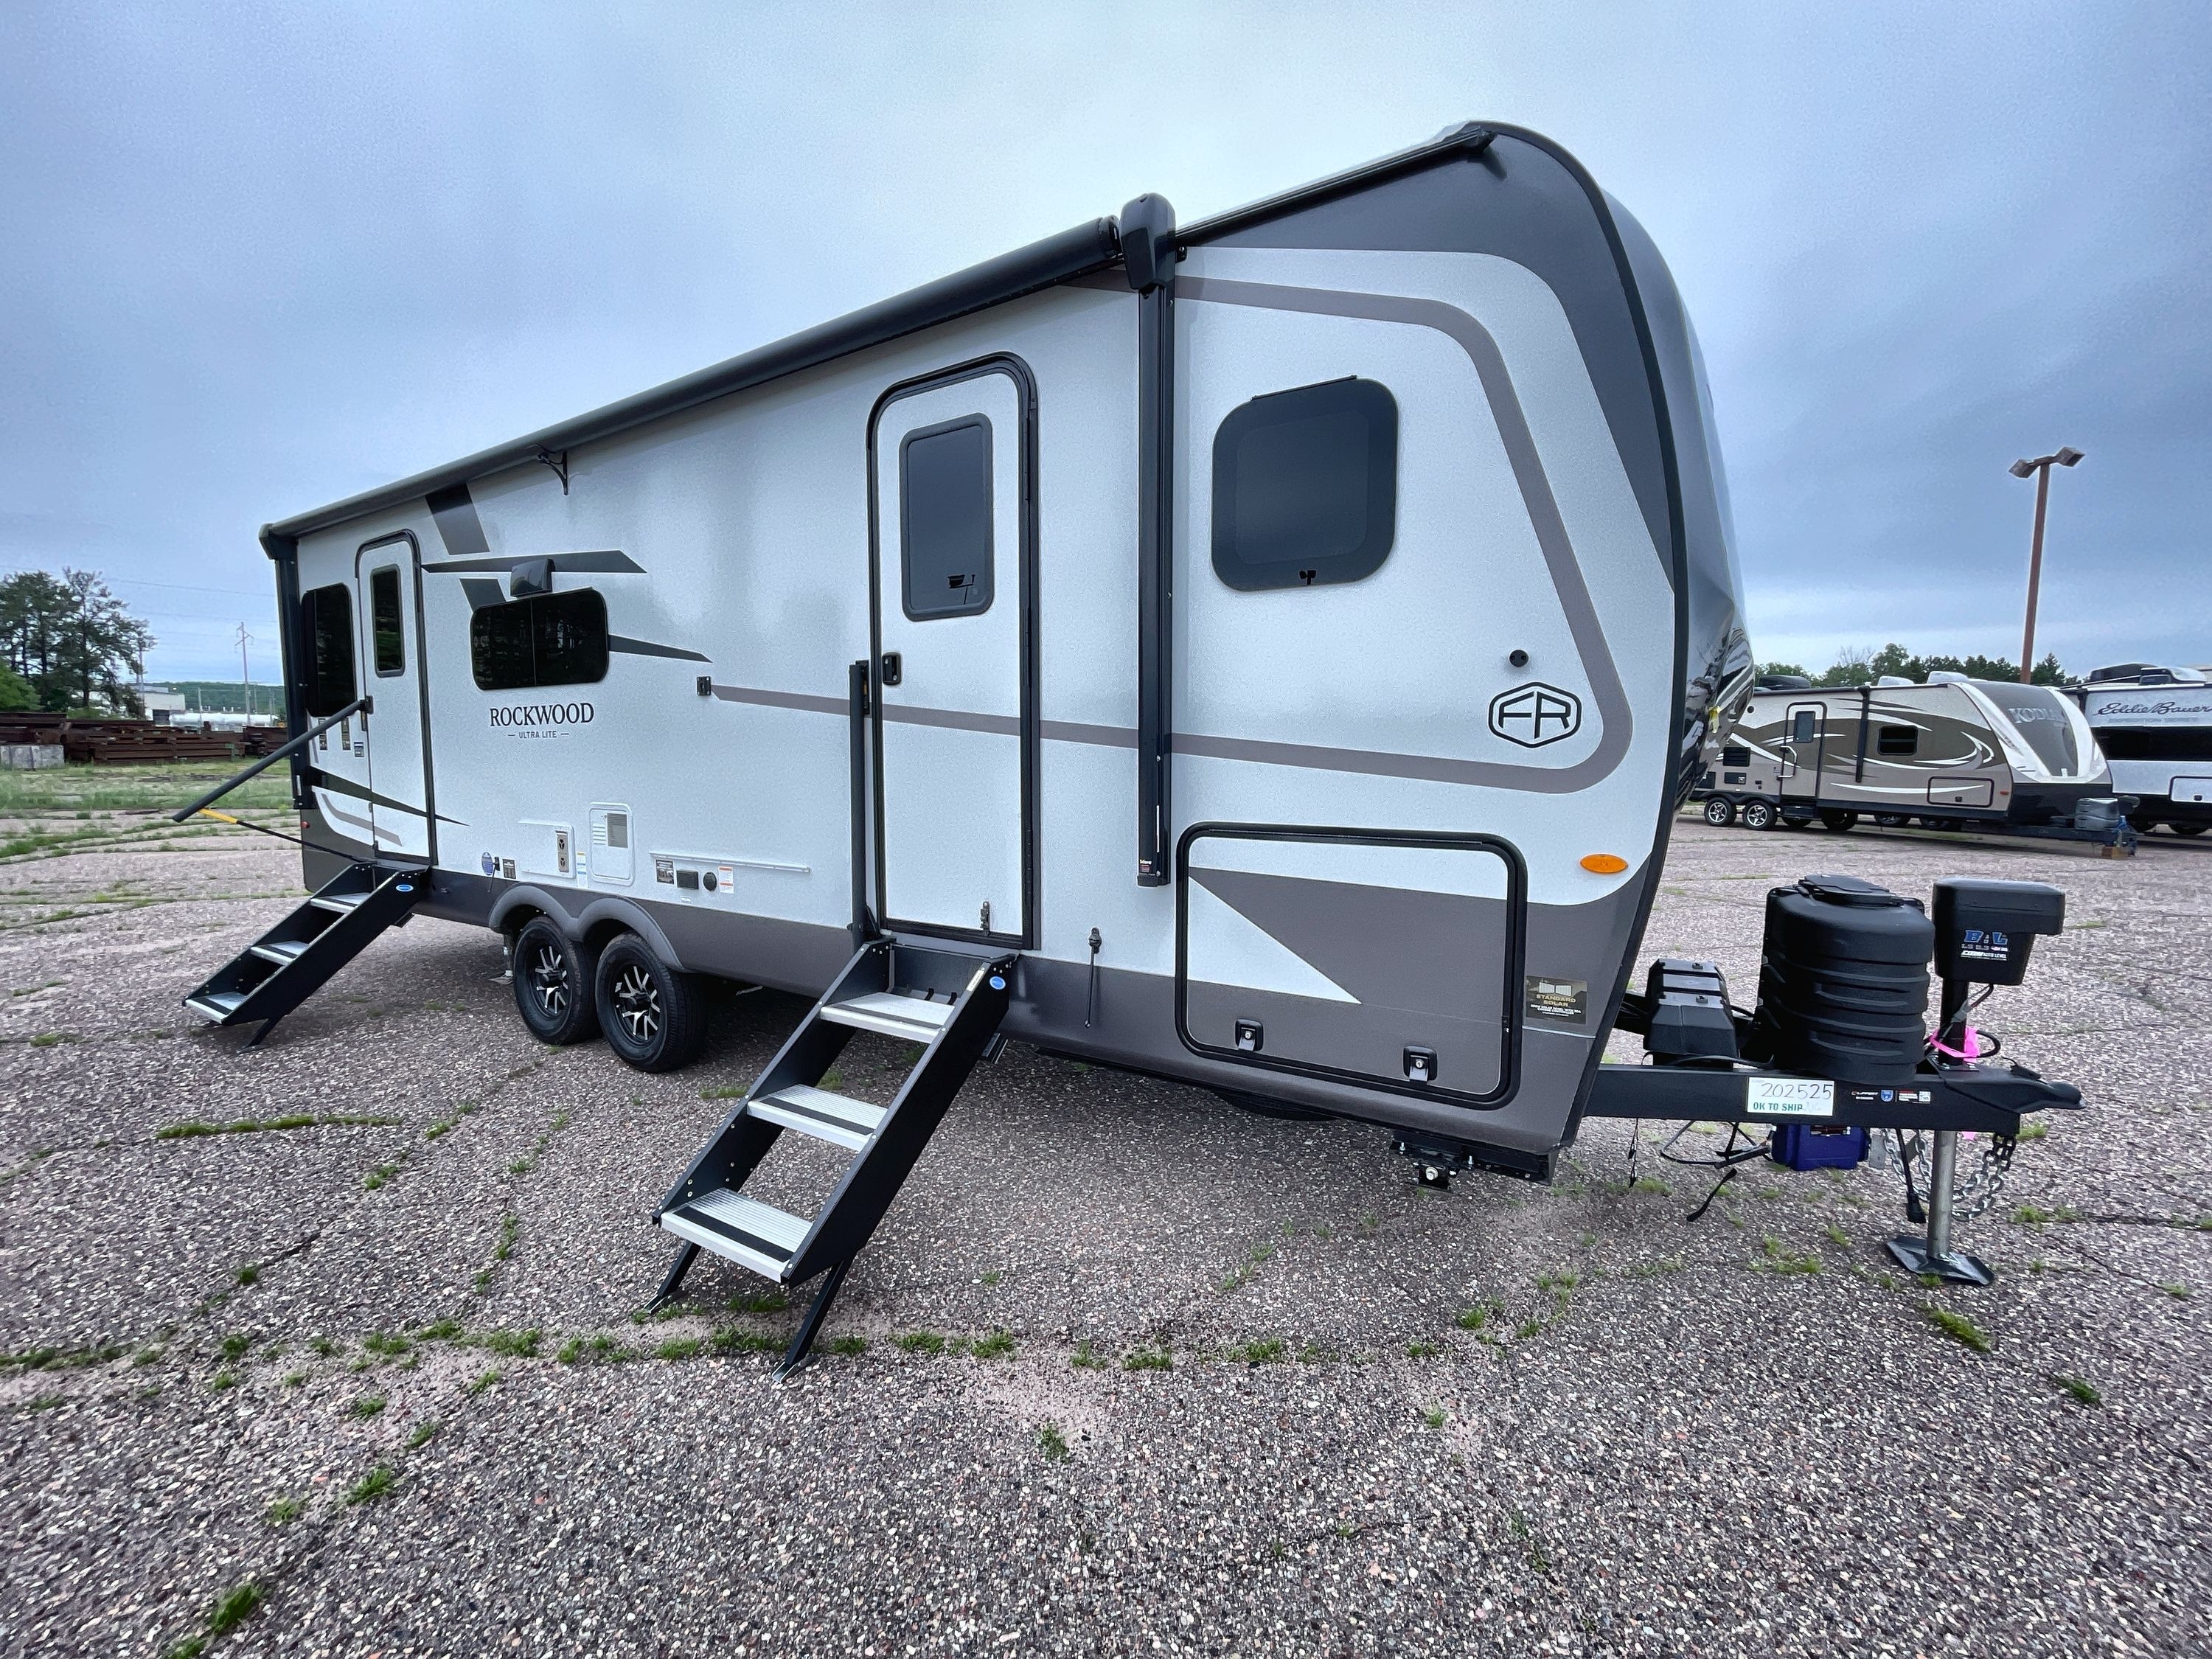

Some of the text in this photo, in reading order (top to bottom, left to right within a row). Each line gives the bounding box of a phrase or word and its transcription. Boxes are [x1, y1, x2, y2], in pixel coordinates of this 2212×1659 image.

[490, 703, 594, 726] ROCKWOOD
[2093, 701, 2212, 715] Eddie Bauer
[1536, 994, 1576, 1003] STANDARD
[1761, 1082, 1833, 1099] 202525
[1753, 1102, 1765, 1110] OK
[1768, 1102, 1779, 1111] TO
[1781, 1103, 1803, 1112] SHIP
